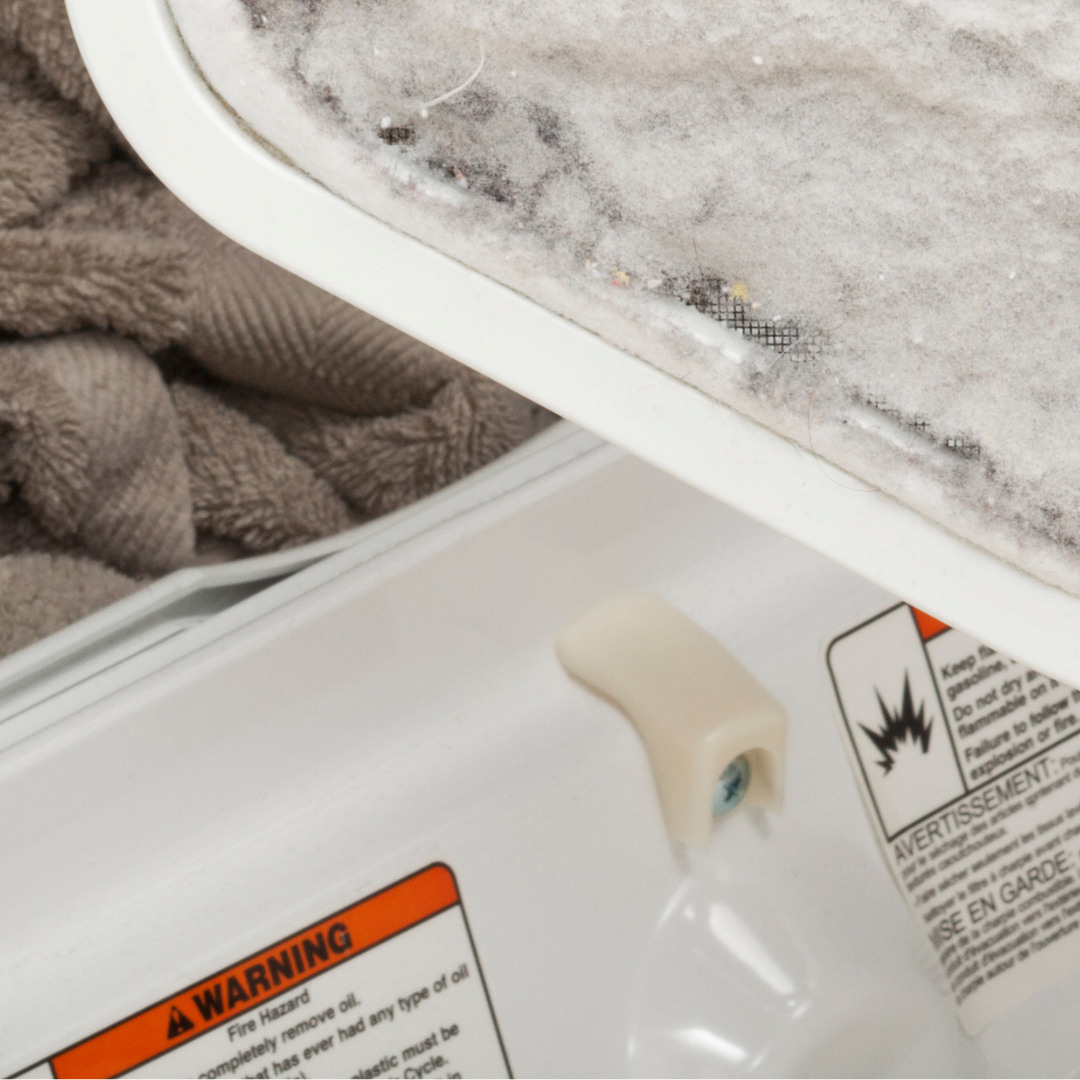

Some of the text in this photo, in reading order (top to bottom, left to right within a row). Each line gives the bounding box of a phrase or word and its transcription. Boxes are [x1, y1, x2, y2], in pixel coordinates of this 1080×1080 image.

[941, 655, 976, 680] Keep
[1029, 683, 1048, 700] on
[952, 704, 973, 722] Do
[975, 688, 999, 709] not
[1000, 676, 1022, 696] dry
[964, 731, 1011, 762] Failure
[1029, 697, 1069, 726] follow
[970, 738, 1034, 780] explosion
[894, 758, 1058, 861] AVERTISSEMENT:
[967, 894, 997, 924] EN
[999, 851, 1070, 904] GARDE:
[192, 922, 354, 1022] WARNING
[227, 987, 311, 1042] Fire Hazard
[272, 1052, 300, 1077] has
[303, 1034, 335, 1060] ever
[337, 1016, 366, 1042] had
[368, 1004, 395, 1027] any
[397, 986, 430, 1013] type
[432, 973, 448, 993] of
[450, 963, 470, 984] oil
[281, 1007, 336, 1043] remove
[338, 992, 361, 1013] oil.
[401, 1031, 439, 1062] must
[439, 1023, 460, 1043] be
